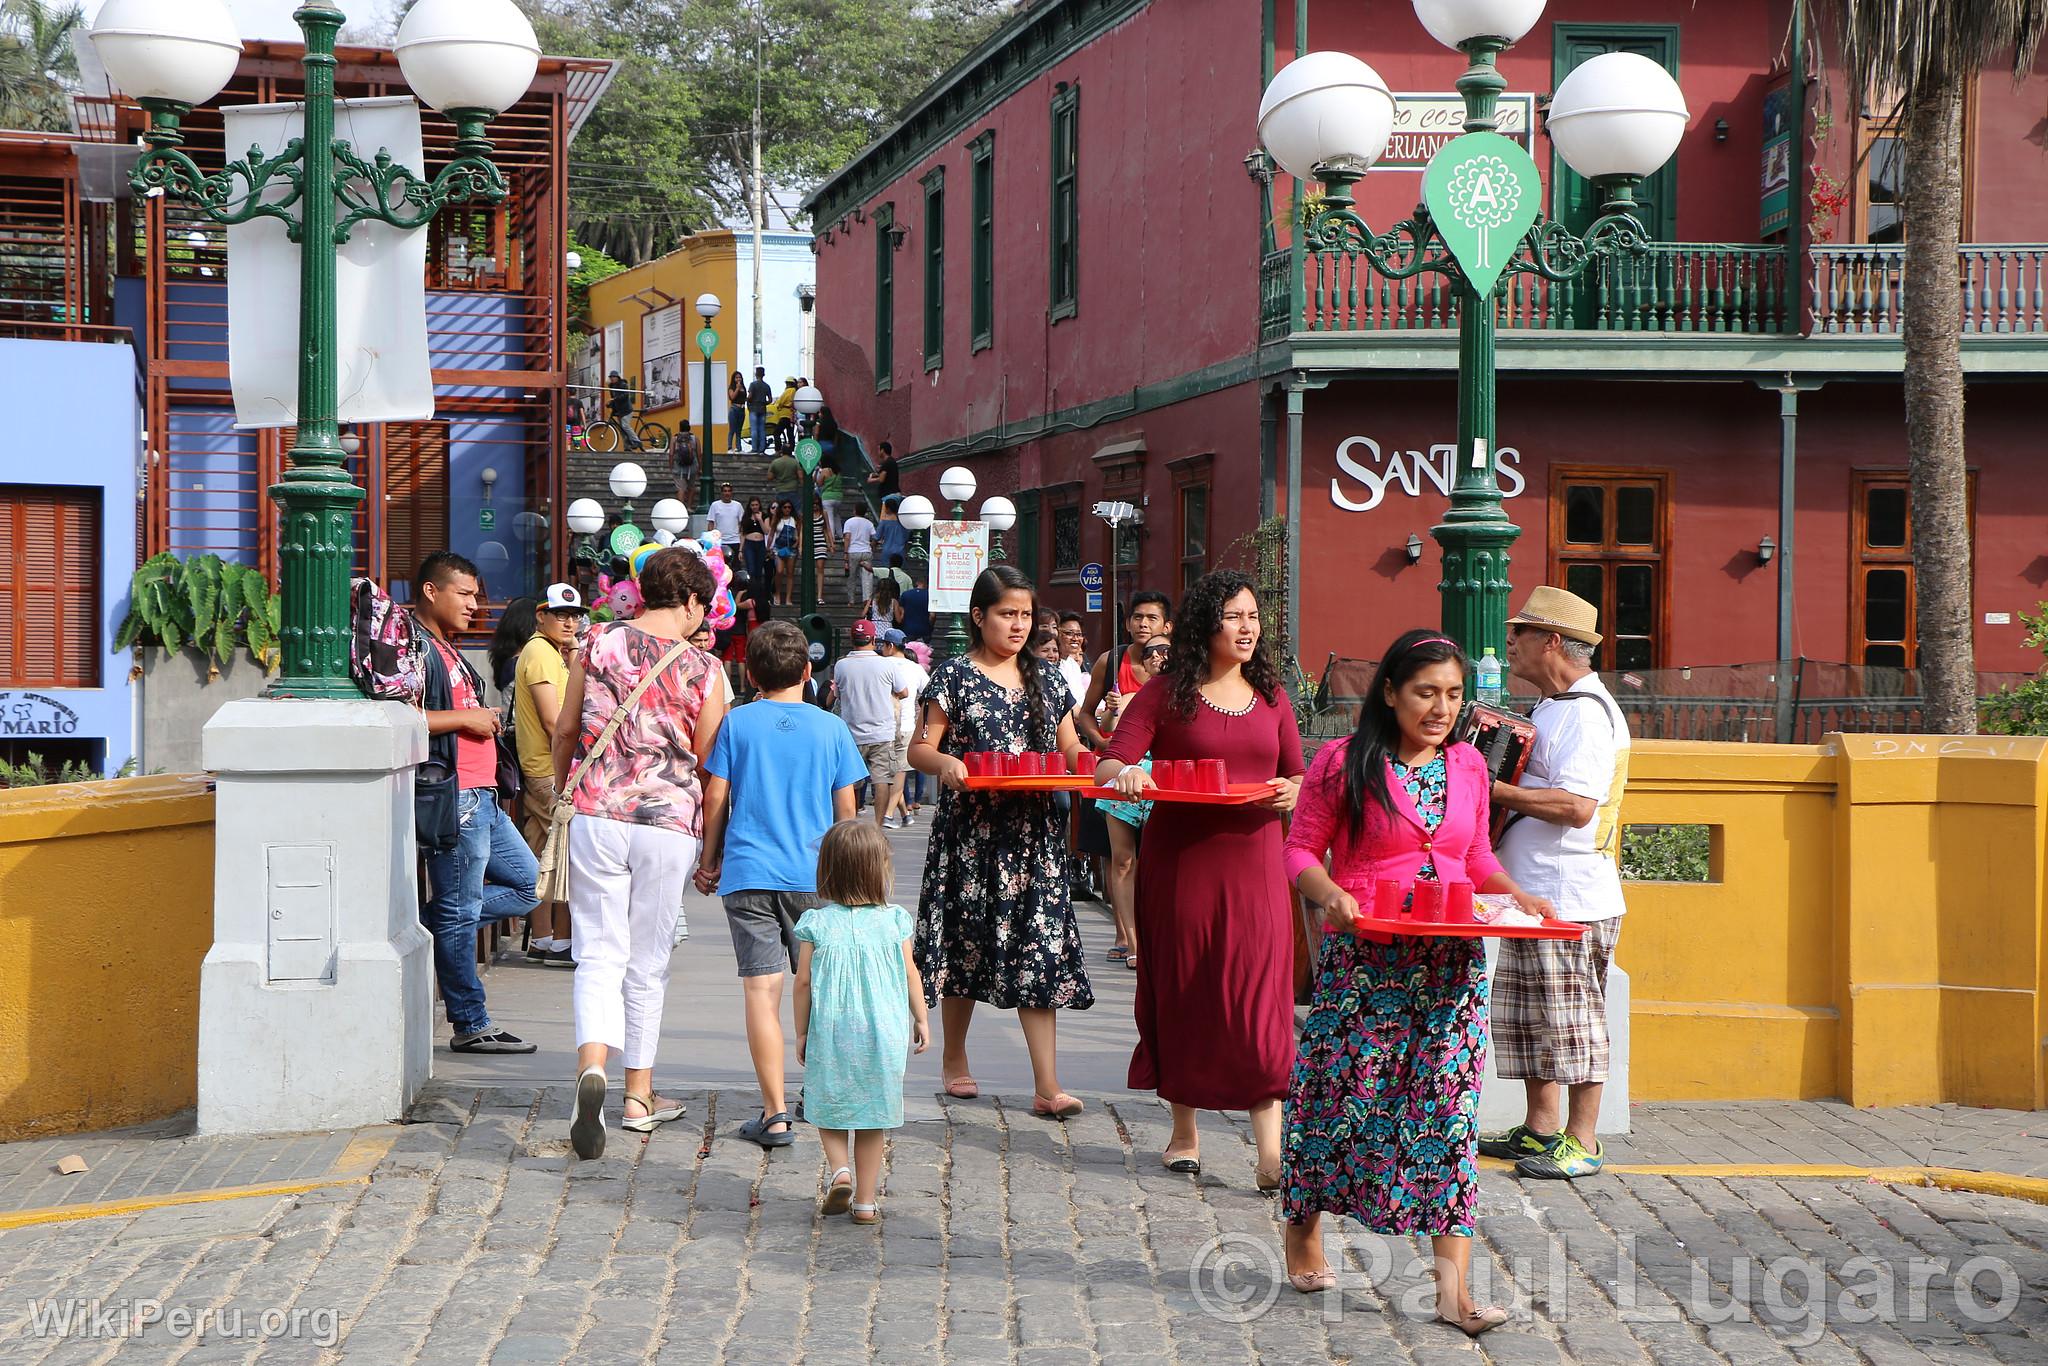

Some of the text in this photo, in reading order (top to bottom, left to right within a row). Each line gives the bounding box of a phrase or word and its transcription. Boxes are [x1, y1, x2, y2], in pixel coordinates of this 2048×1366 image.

[1385, 134, 1450, 159] ERUAN
[1469, 174, 1498, 208] A
[1331, 435, 1526, 512] SANTS
[1082, 577, 1103, 585] VISA
[3, 711, 76, 734] MARIO
